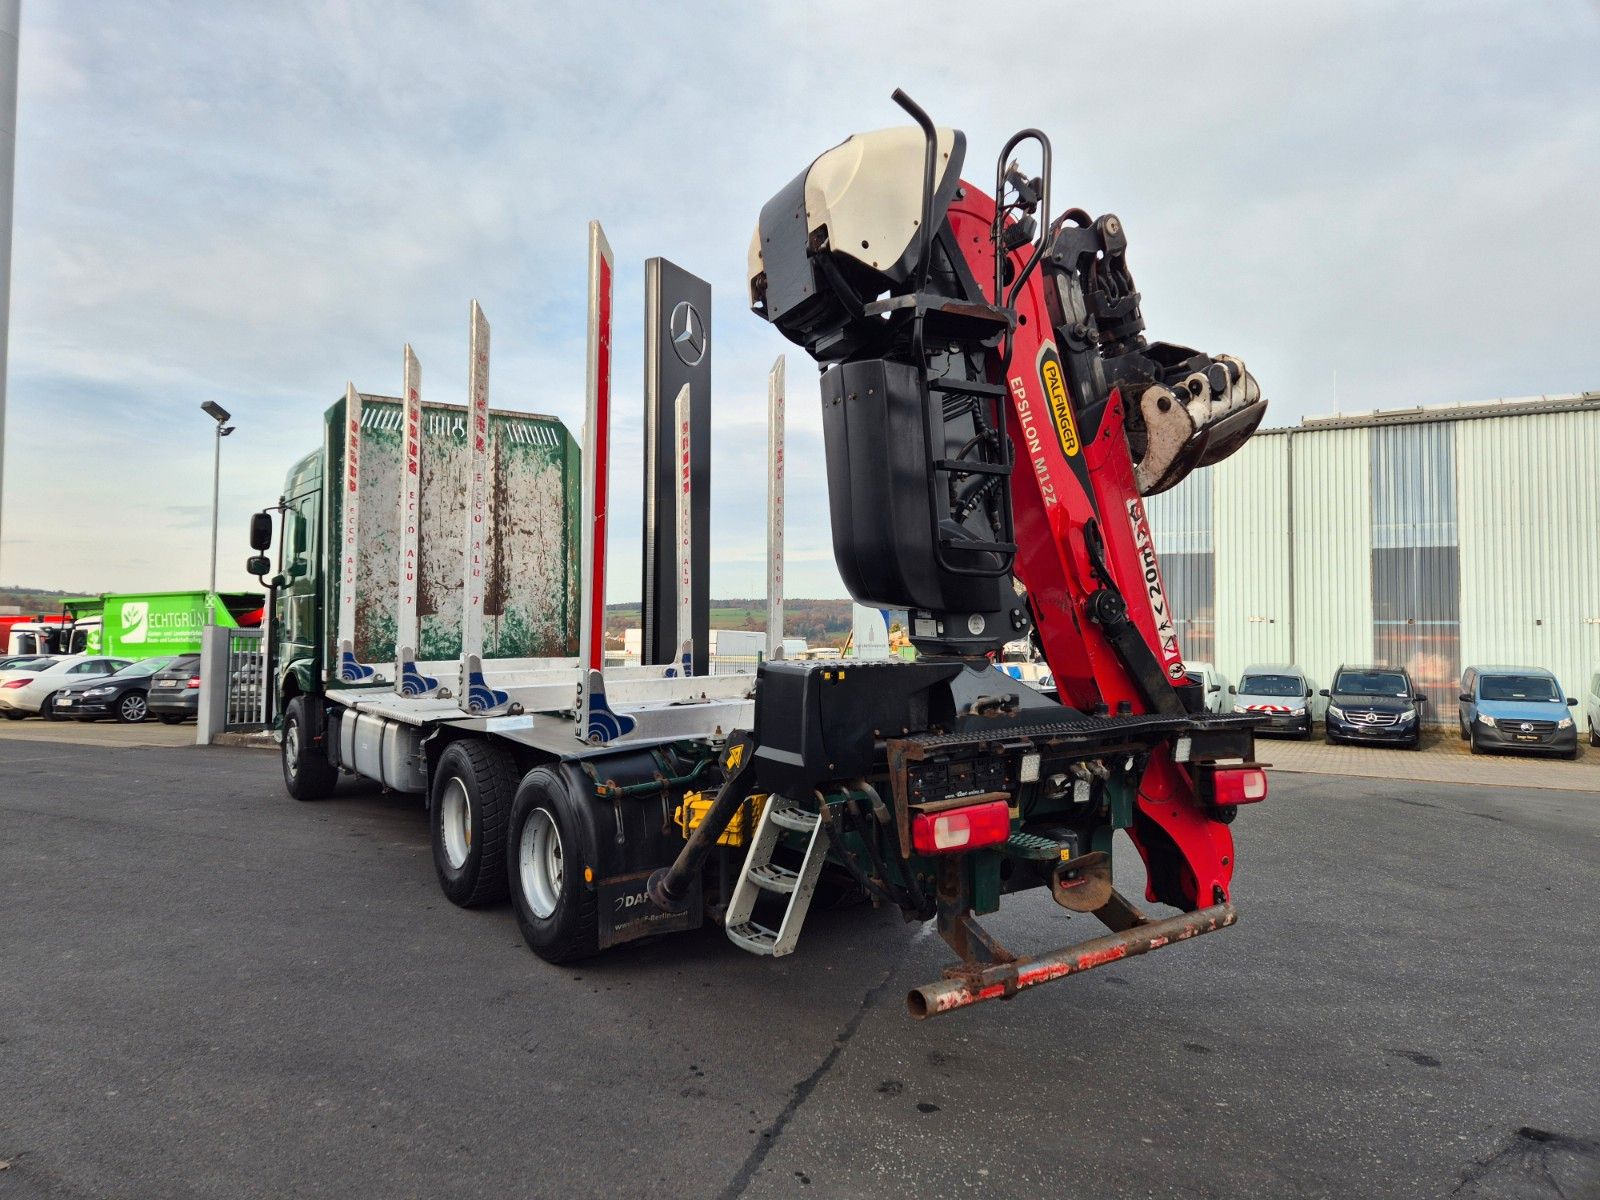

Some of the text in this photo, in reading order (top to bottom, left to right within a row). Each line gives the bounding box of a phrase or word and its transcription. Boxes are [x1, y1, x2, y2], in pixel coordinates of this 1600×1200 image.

[1045, 365, 1077, 451] PALFINGER
[1010, 376, 1058, 508] EPSILON M12Z
[406, 549, 414, 581] ALU
[148, 609, 205, 628] ECHTGRÜN
